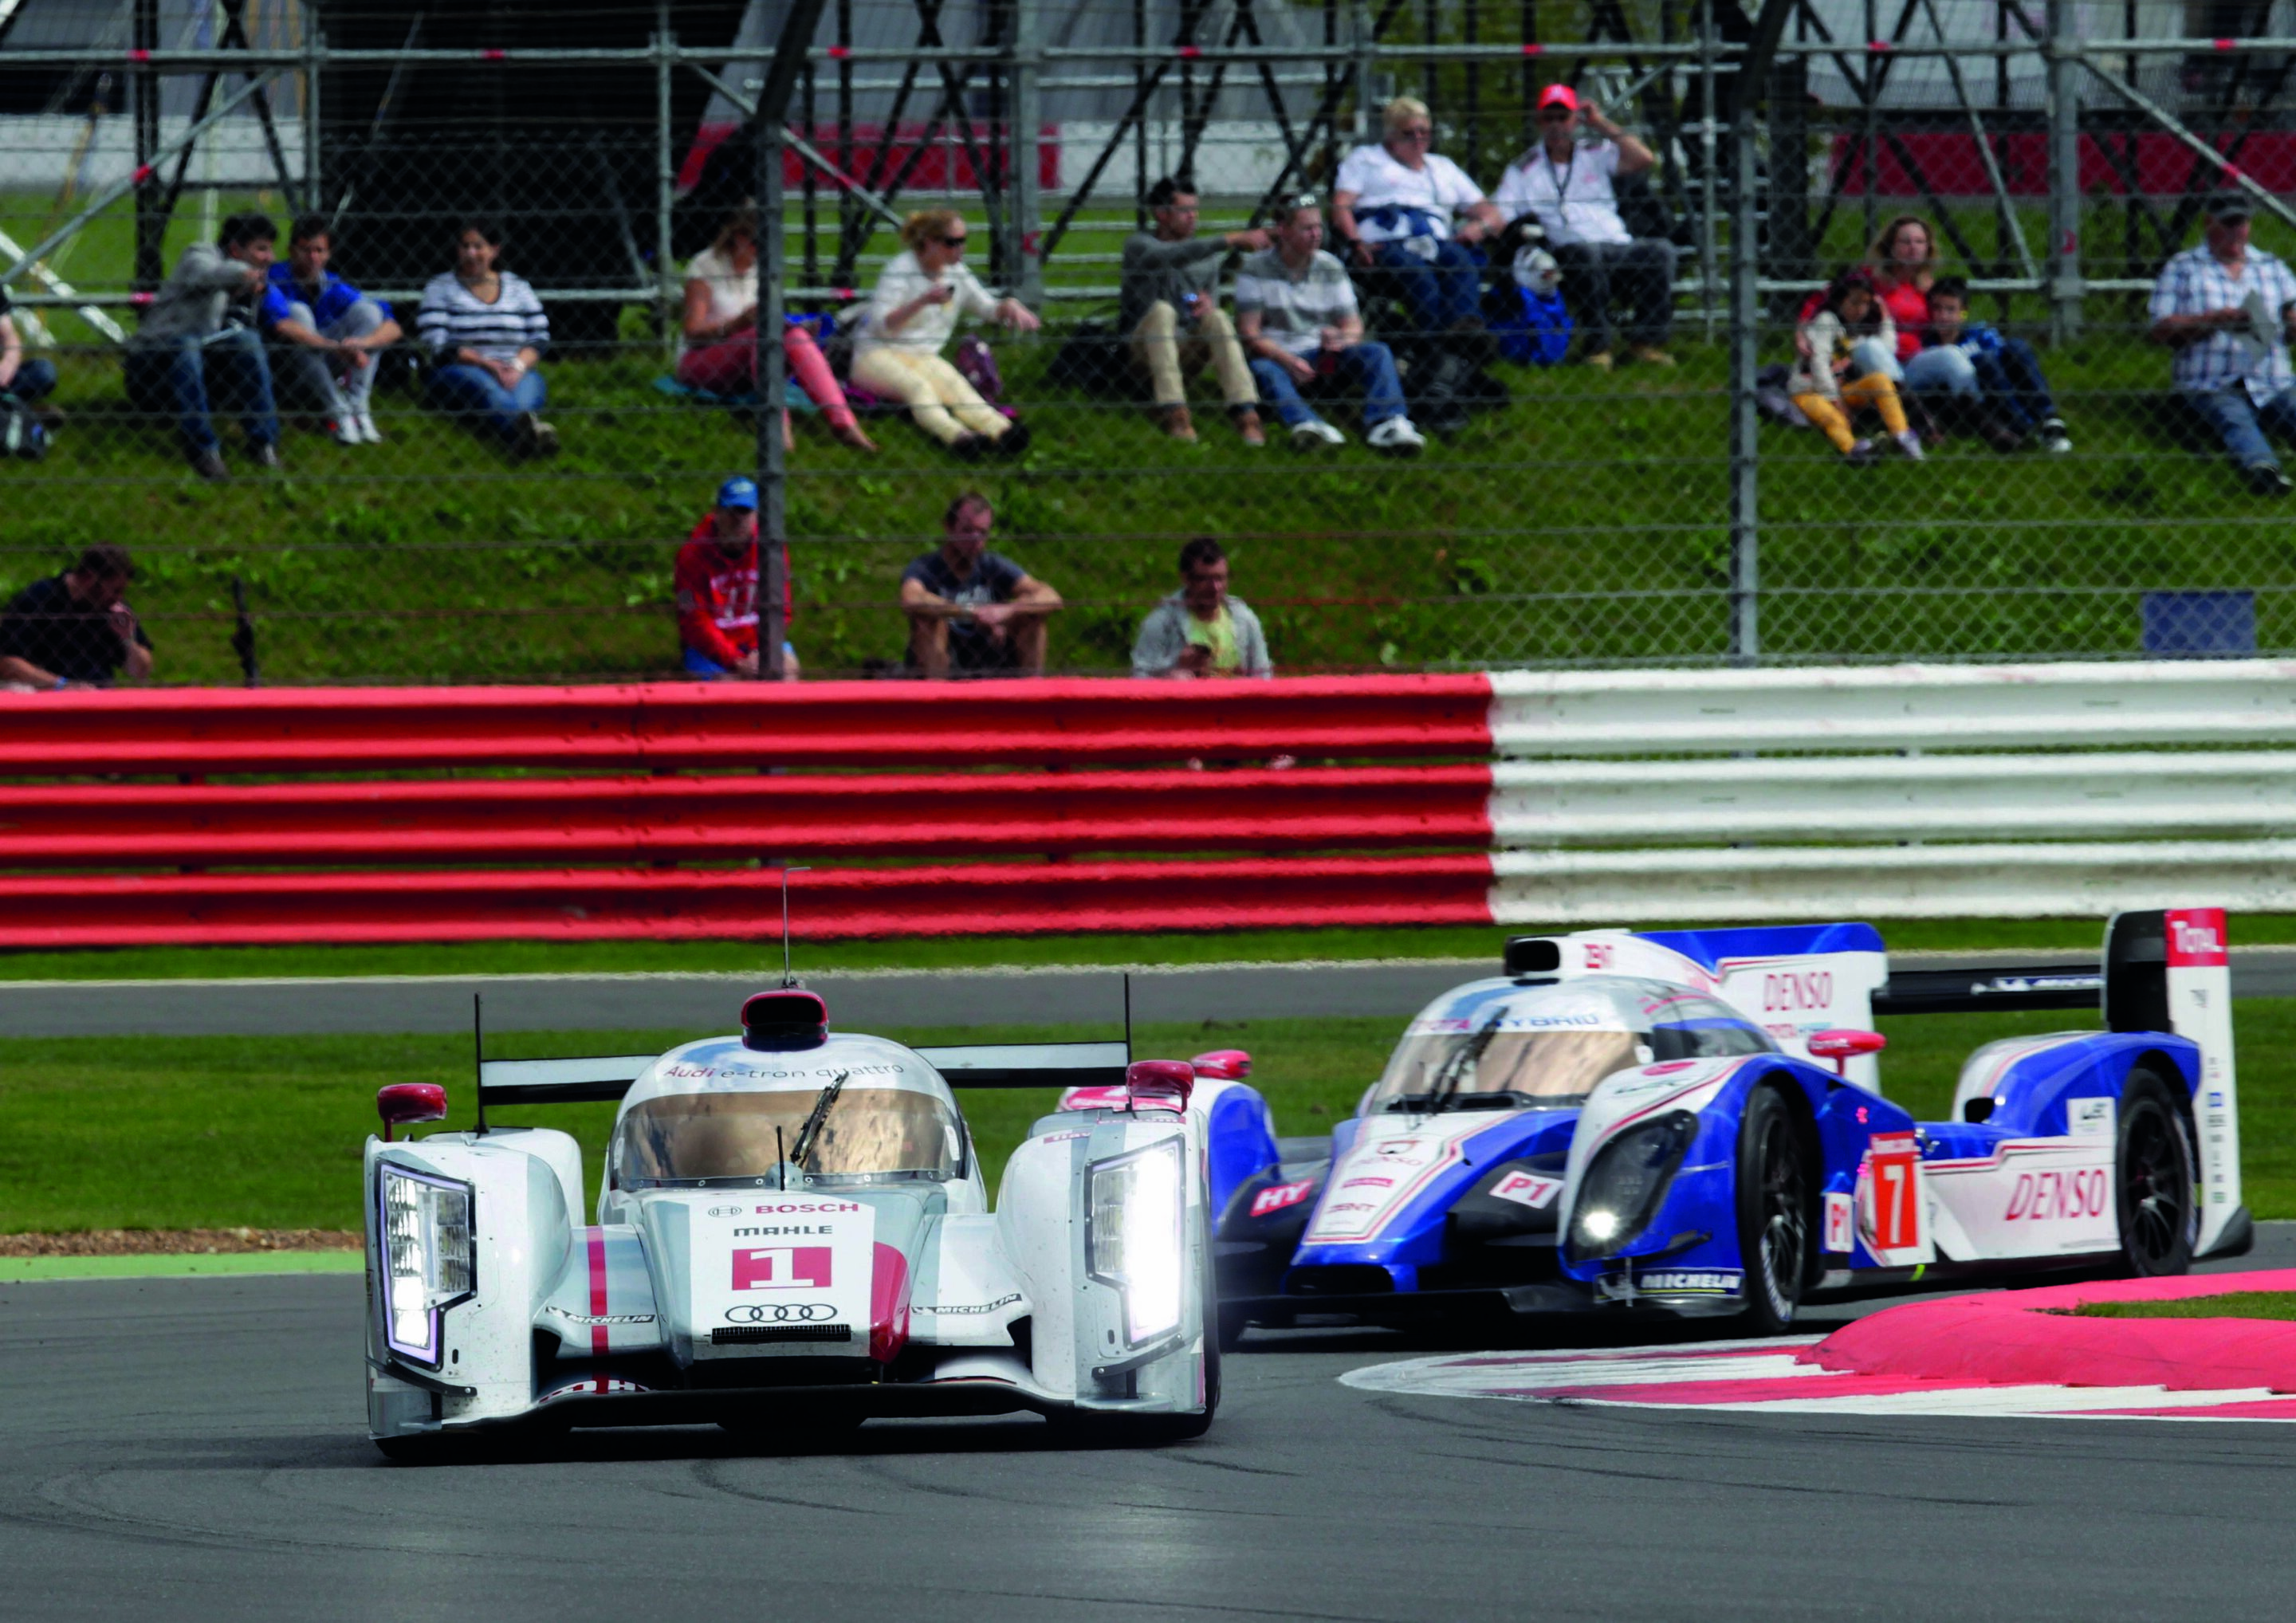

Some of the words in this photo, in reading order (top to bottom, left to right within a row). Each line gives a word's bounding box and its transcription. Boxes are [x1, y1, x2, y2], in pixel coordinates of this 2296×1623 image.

[1764, 971, 1833, 1012] DENSO
[664, 1065, 716, 1077] Audi
[721, 1068, 806, 1078] e-tron
[816, 1063, 905, 1079] quattro
[1253, 1180, 1315, 1212] HY
[1500, 1177, 1551, 1201] P1
[2004, 1169, 2107, 1221] DENSO
[756, 1203, 859, 1214] BOSCH
[1883, 1165, 1905, 1244] 7
[733, 1225, 833, 1237] MAHLE
[1831, 1203, 1850, 1243] P1
[749, 1248, 815, 1289] 1
[1640, 1273, 1741, 1289] MICHELIN
[935, 1293, 1019, 1314] MICHELIN
[567, 1314, 653, 1323] MICHELIN
